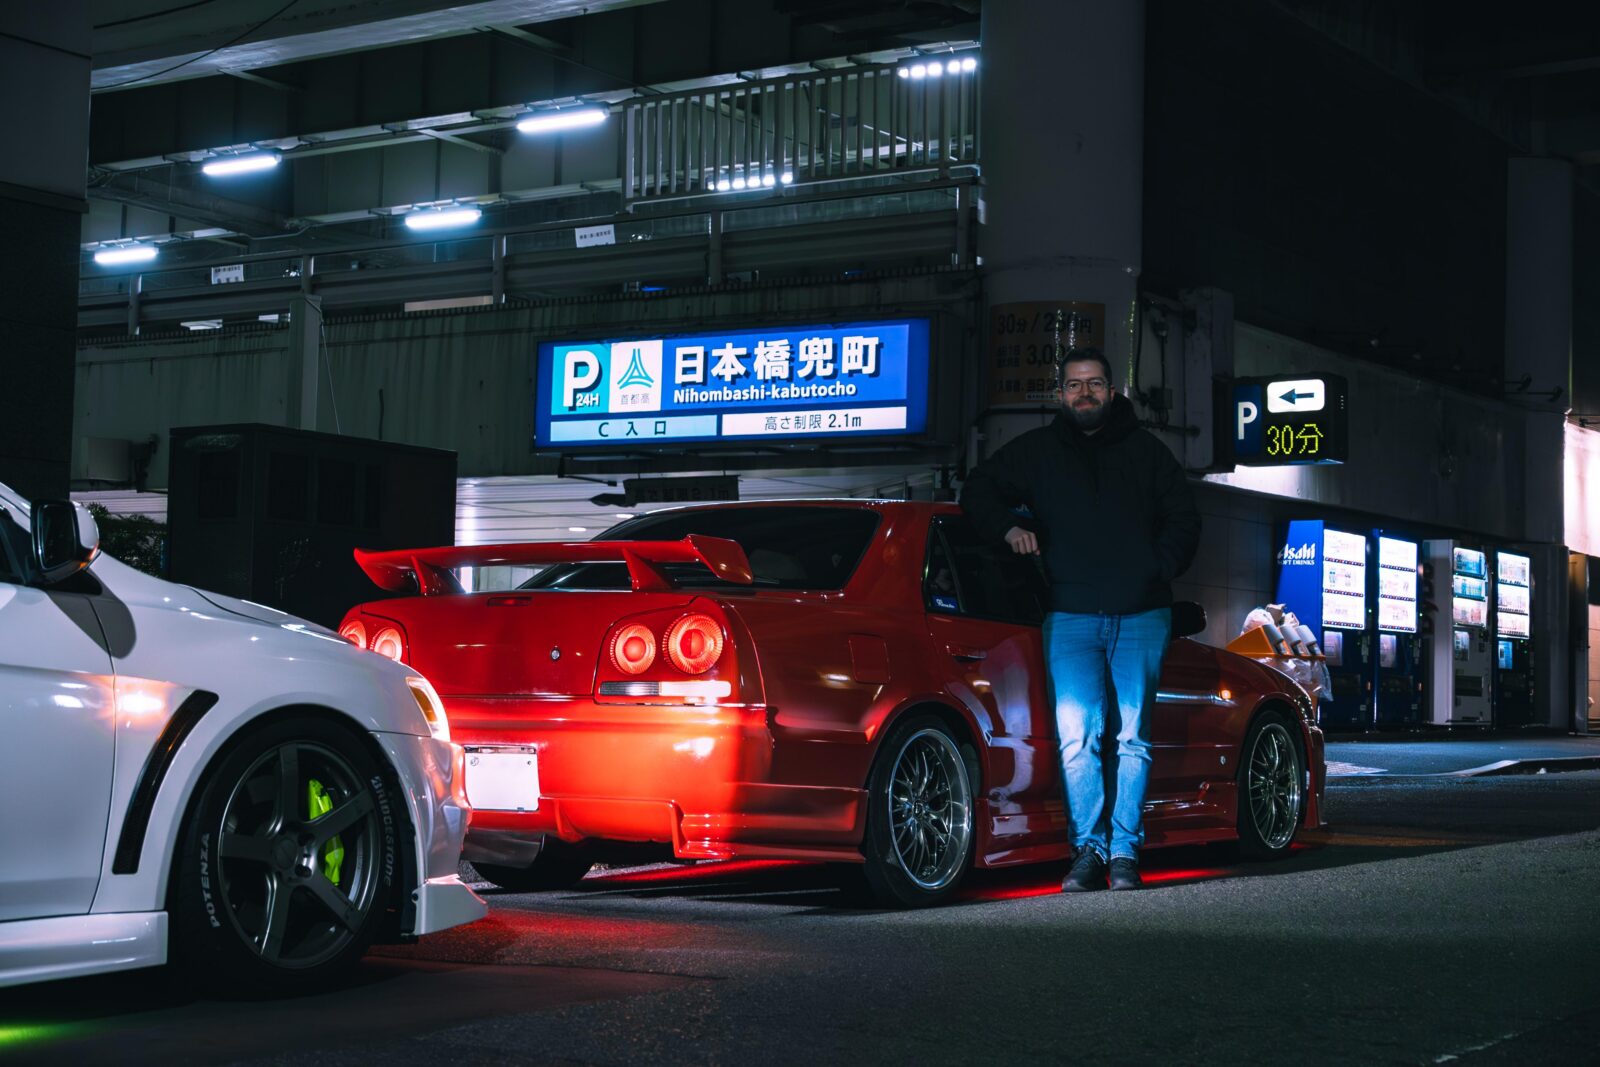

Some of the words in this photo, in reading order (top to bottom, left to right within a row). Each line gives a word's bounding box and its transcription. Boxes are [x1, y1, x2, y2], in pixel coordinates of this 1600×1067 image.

[675, 336, 879, 384] 日本橋兜町
[563, 350, 600, 407] P
[674, 381, 856, 403] Nihombashi-kabutocho
[576, 392, 600, 407] 24H
[621, 393, 649, 405] 首都高
[1238, 401, 1258, 440] P
[1267, 423, 1324, 455] 30分
[1277, 543, 1316, 560] Asahi
[200, 832, 221, 928] POTENZA
